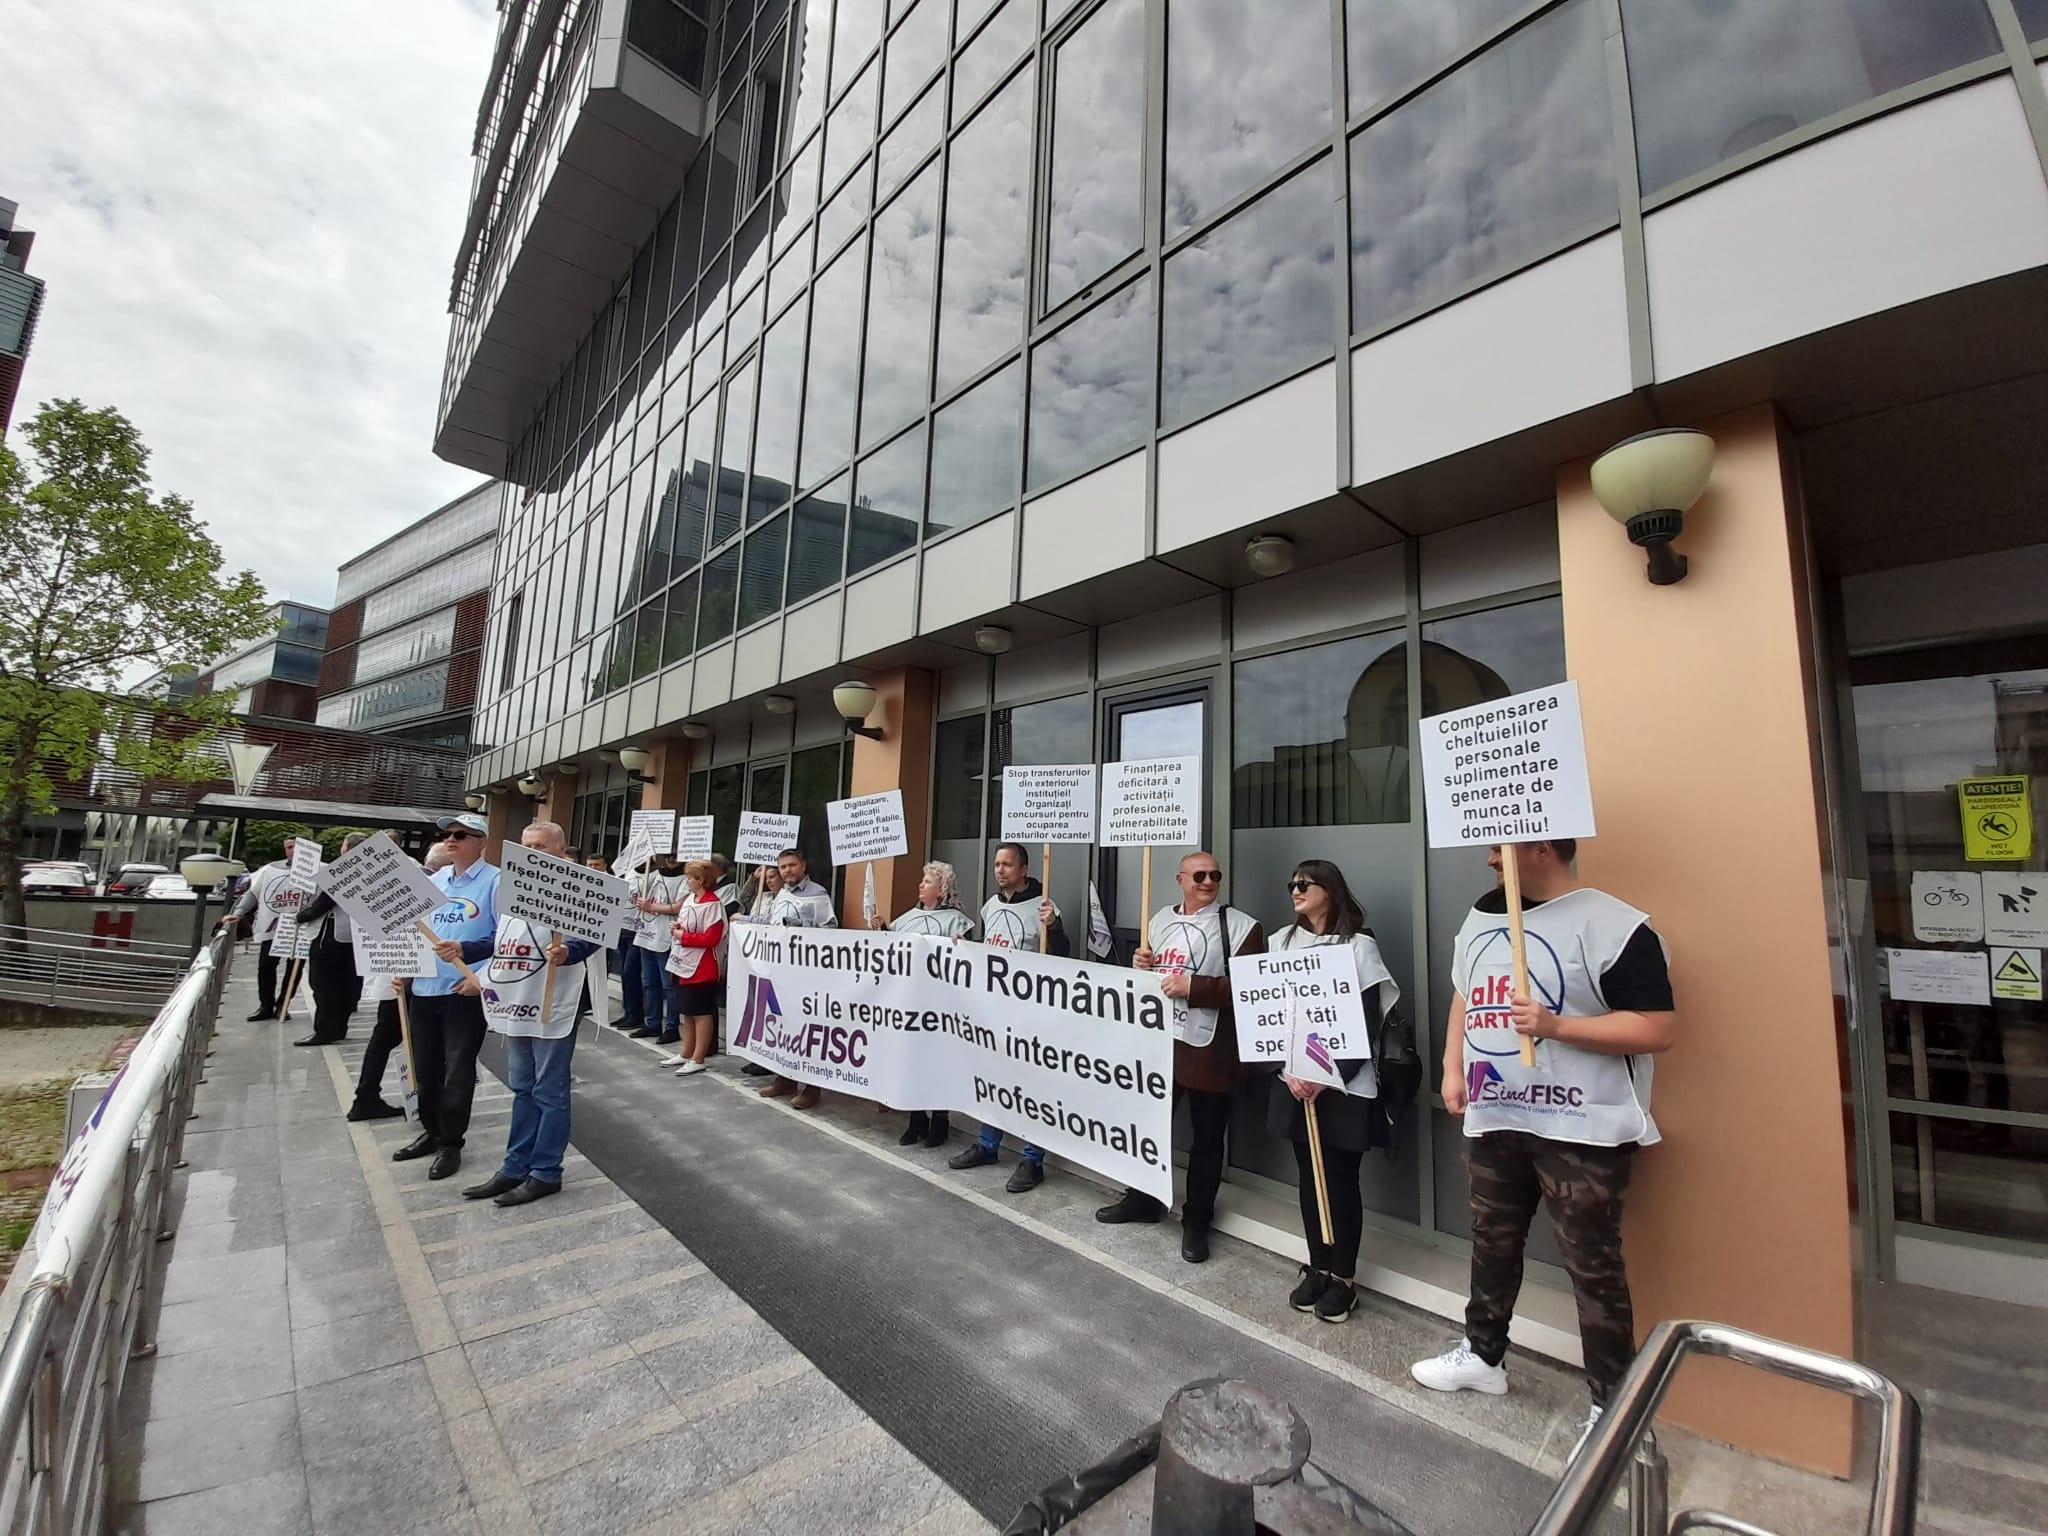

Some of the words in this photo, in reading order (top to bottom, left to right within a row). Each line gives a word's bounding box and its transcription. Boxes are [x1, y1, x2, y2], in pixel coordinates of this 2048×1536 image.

[1439, 696, 1559, 734] Compensarea
[1445, 718, 1549, 750] cheltuielilor
[1455, 739, 1541, 770] personale
[1008, 769, 1028, 779] Stop
[1031, 768, 1091, 777] transferurilor
[1123, 763, 1182, 775] Finanțarea
[1444, 757, 1559, 787] suplimentare
[1035, 779, 1079, 787] exteriorul
[1118, 776, 1168, 788] deficitară
[1174, 777, 1181, 785] a
[1967, 783, 2022, 794] ATENȚIE!
[1025, 790, 1071, 799] instituției!
[1123, 789, 1174, 802] activității
[1451, 782, 1525, 807] generate
[1531, 777, 1554, 793] de
[844, 796, 889, 810] Digitalizare,
[1025, 800, 1071, 810] Organizați
[1113, 803, 1184, 816] profesionale,
[1463, 803, 1521, 820] munca
[1526, 799, 1543, 814] la
[752, 815, 789, 827] Evaluări
[1007, 810, 1056, 818] concursuri
[1058, 811, 1089, 820] pentru
[1109, 817, 1188, 828] vulnerabilitate
[740, 827, 797, 840] profesionale
[831, 820, 874, 832] informatice
[845, 830, 871, 839] sistem
[1026, 822, 1069, 830] ocuparea
[1461, 817, 1550, 839] domiciliu!
[1005, 831, 1049, 840] posturilor
[1051, 831, 1091, 839] vacante!
[1110, 830, 1186, 843] instituțională!
[836, 841, 862, 851] nivelul
[329, 854, 362, 878] Politica
[362, 846, 376, 857] de
[742, 851, 780, 862] obiectiv
[527, 854, 605, 887] Corelarea
[327, 867, 364, 895] personal
[506, 861, 558, 885] fișelor
[561, 881, 581, 893] de
[585, 889, 621, 906] post
[342, 884, 362, 900] spre
[514, 880, 533, 891] cu
[538, 887, 610, 916] realitățile
[380, 894, 418, 921] structurii
[381, 898, 435, 935] personalului!
[516, 894, 605, 928] activităților
[433, 913, 465, 924] FNSA
[510, 905, 606, 941] desfășurate!
[500, 938, 531, 956] alfa
[1258, 954, 1321, 976] Funcții
[742, 931, 782, 964] Unim
[789, 934, 912, 985] finanțiștii
[926, 946, 973, 988] din
[986, 954, 1166, 1031] România
[1333, 978, 1351, 995] la
[1471, 975, 1510, 1006] alf
[1257, 1006, 1338, 1027] actități
[1466, 1012, 1513, 1030] CART
[765, 1014, 868, 1068] SindFISC
[802, 992, 818, 1016] si
[826, 993, 842, 1019] le
[850, 1002, 997, 1051] reprezentăm
[1006, 1027, 1167, 1100] interesele
[836, 1069, 869, 1087] Publice
[1482, 1082, 1584, 1107] SindFISC
[974, 1075, 1168, 1172] profesionale.
